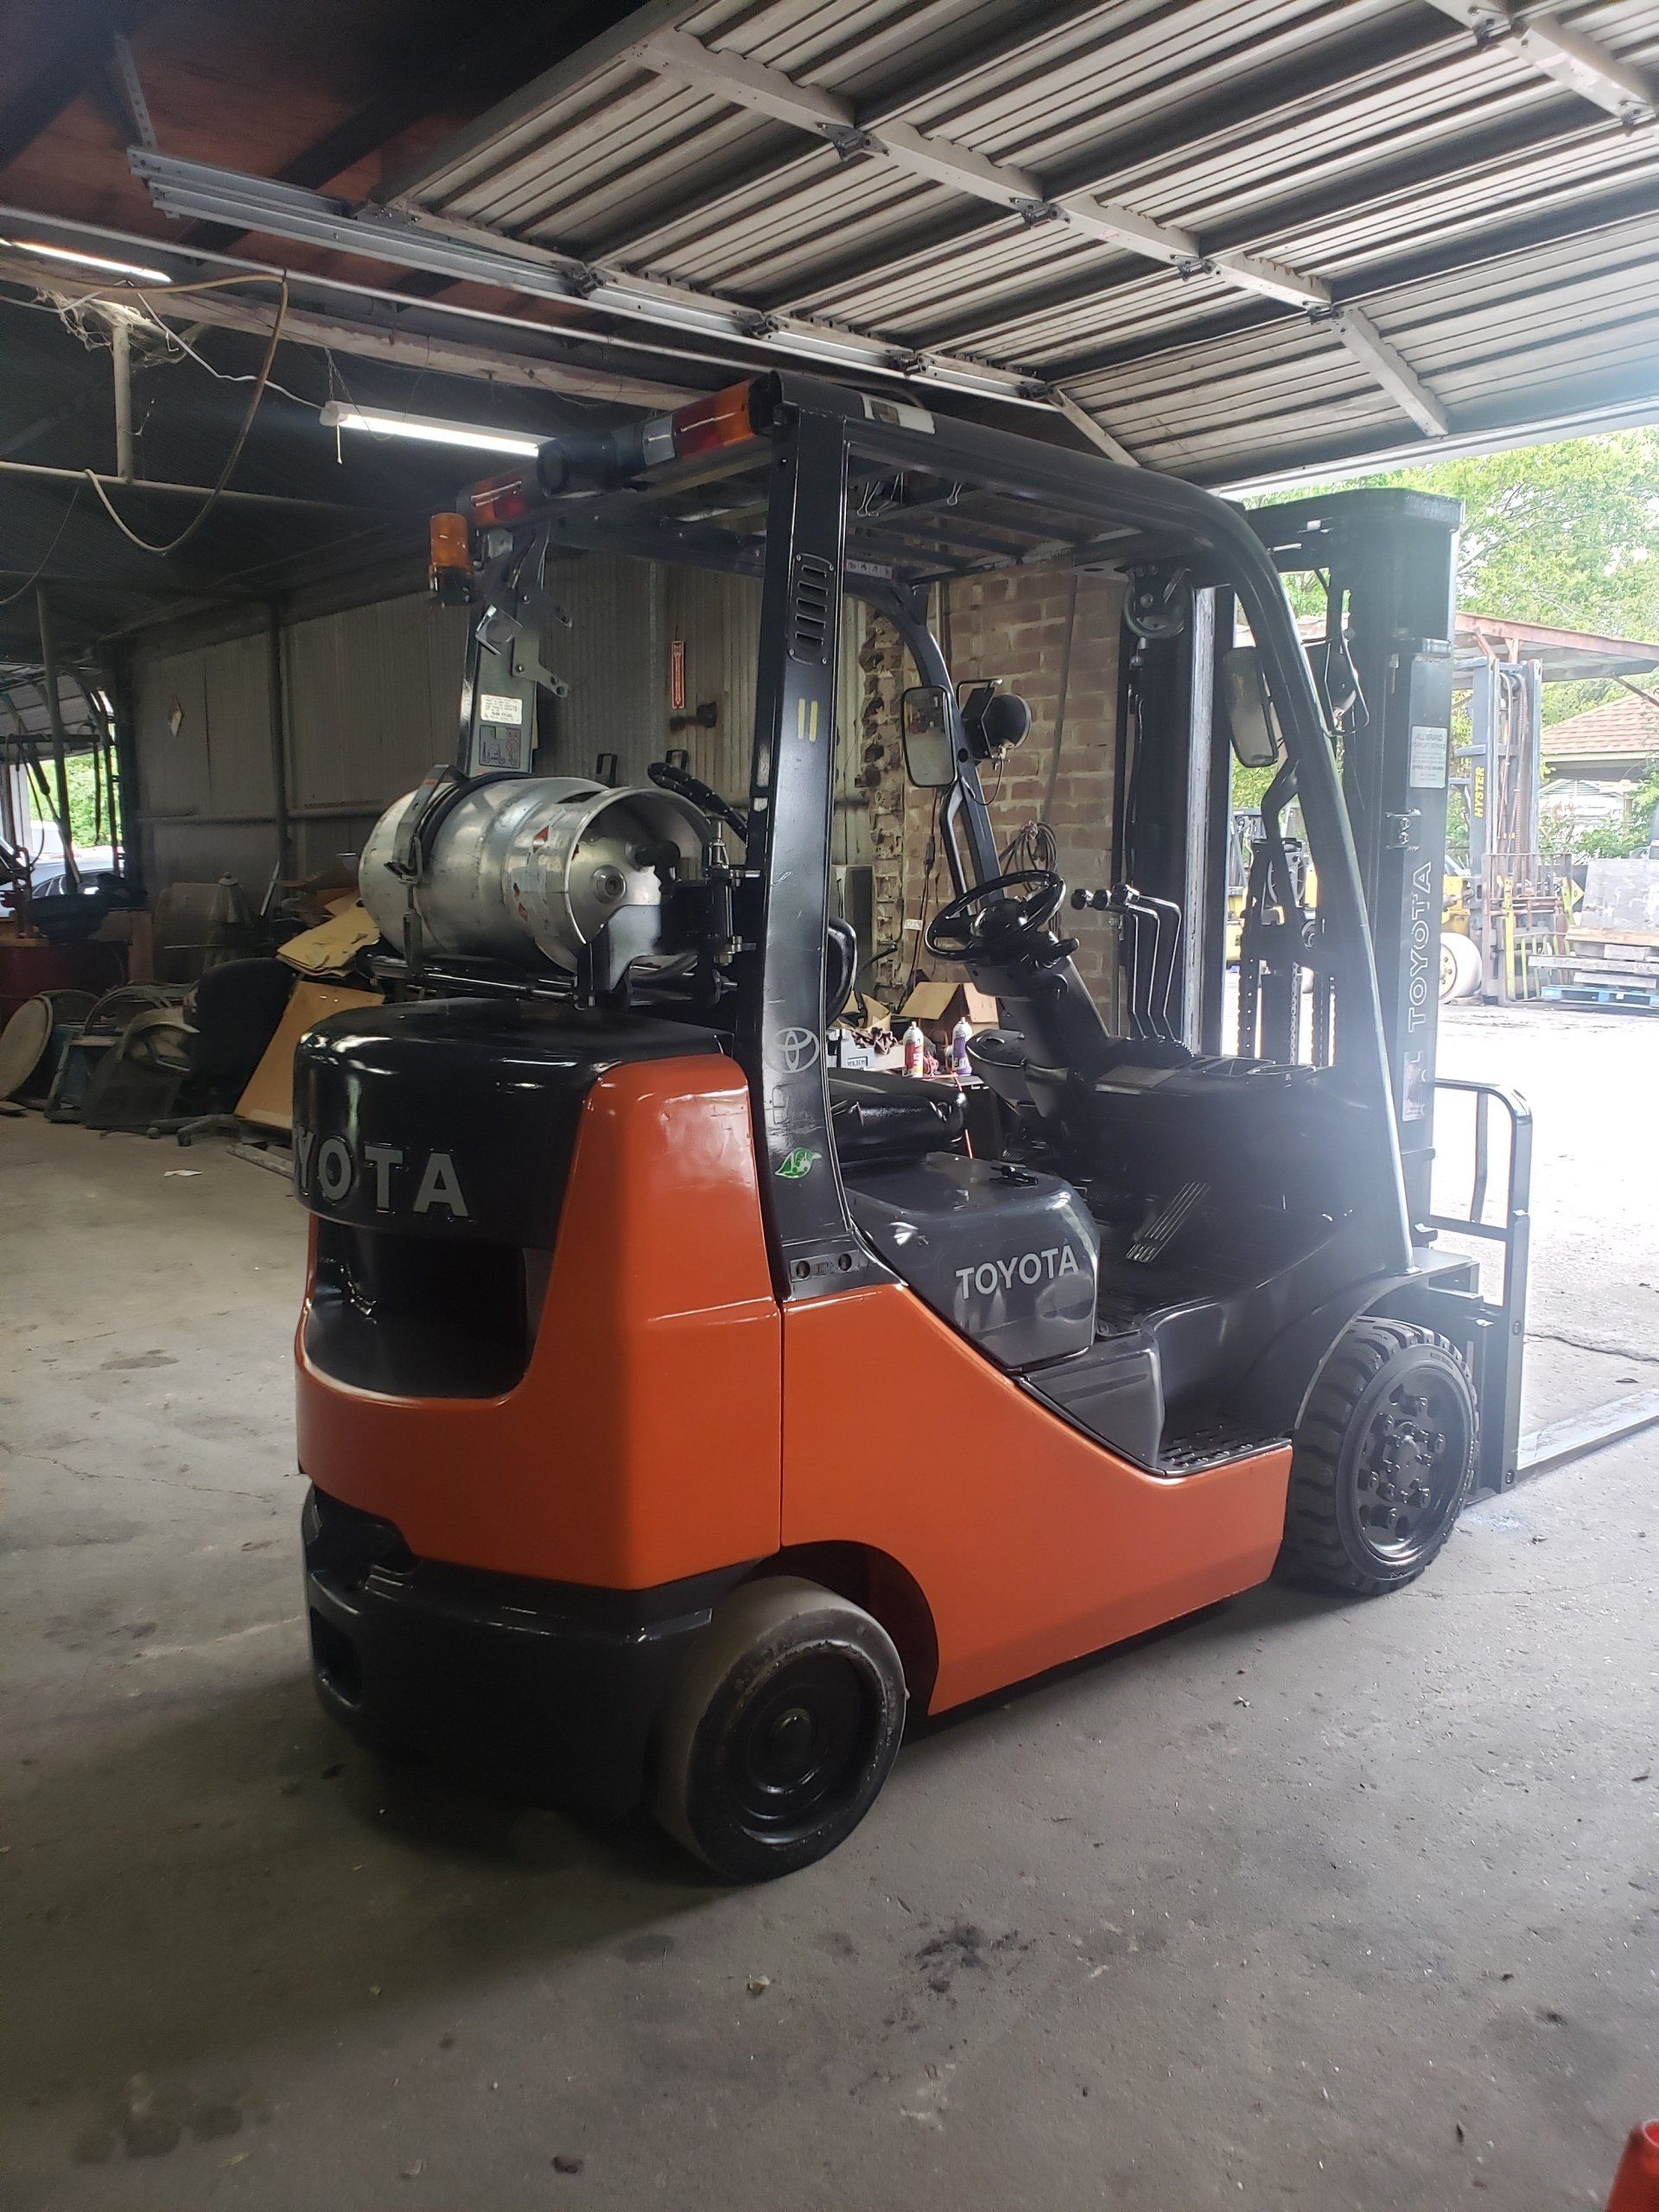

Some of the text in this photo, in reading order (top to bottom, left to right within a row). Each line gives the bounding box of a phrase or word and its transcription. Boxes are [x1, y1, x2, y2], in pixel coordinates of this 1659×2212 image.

[1474, 767, 1484, 817] HYSTER
[1408, 861, 1432, 1033] TOYOTA
[955, 1245, 1079, 1300] TOYOTA
